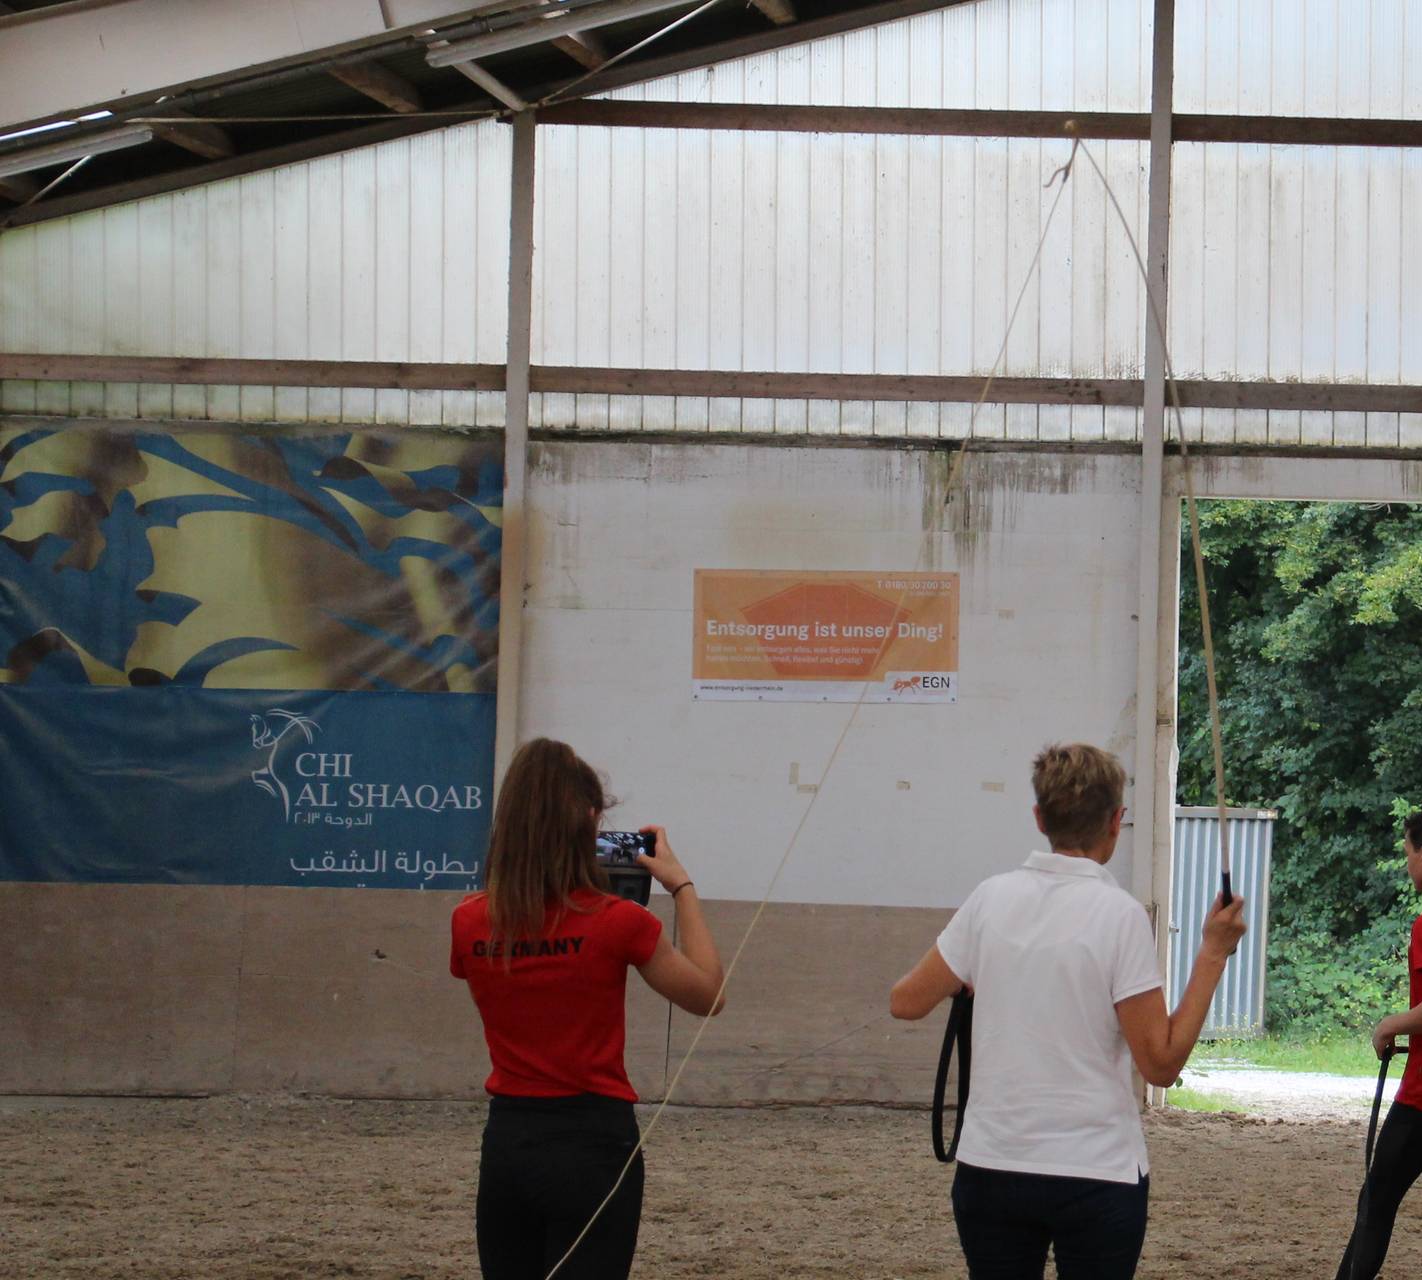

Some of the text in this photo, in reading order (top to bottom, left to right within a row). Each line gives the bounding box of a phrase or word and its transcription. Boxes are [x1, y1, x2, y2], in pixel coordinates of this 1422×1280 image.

[706, 620, 944, 641] Entsorgung ist unser Ding!
[922, 676, 950, 688] EGN
[295, 752, 353, 777] CHI
[294, 783, 482, 813] AL SHAQAB
[290, 849, 479, 881] بطولة الشقب
